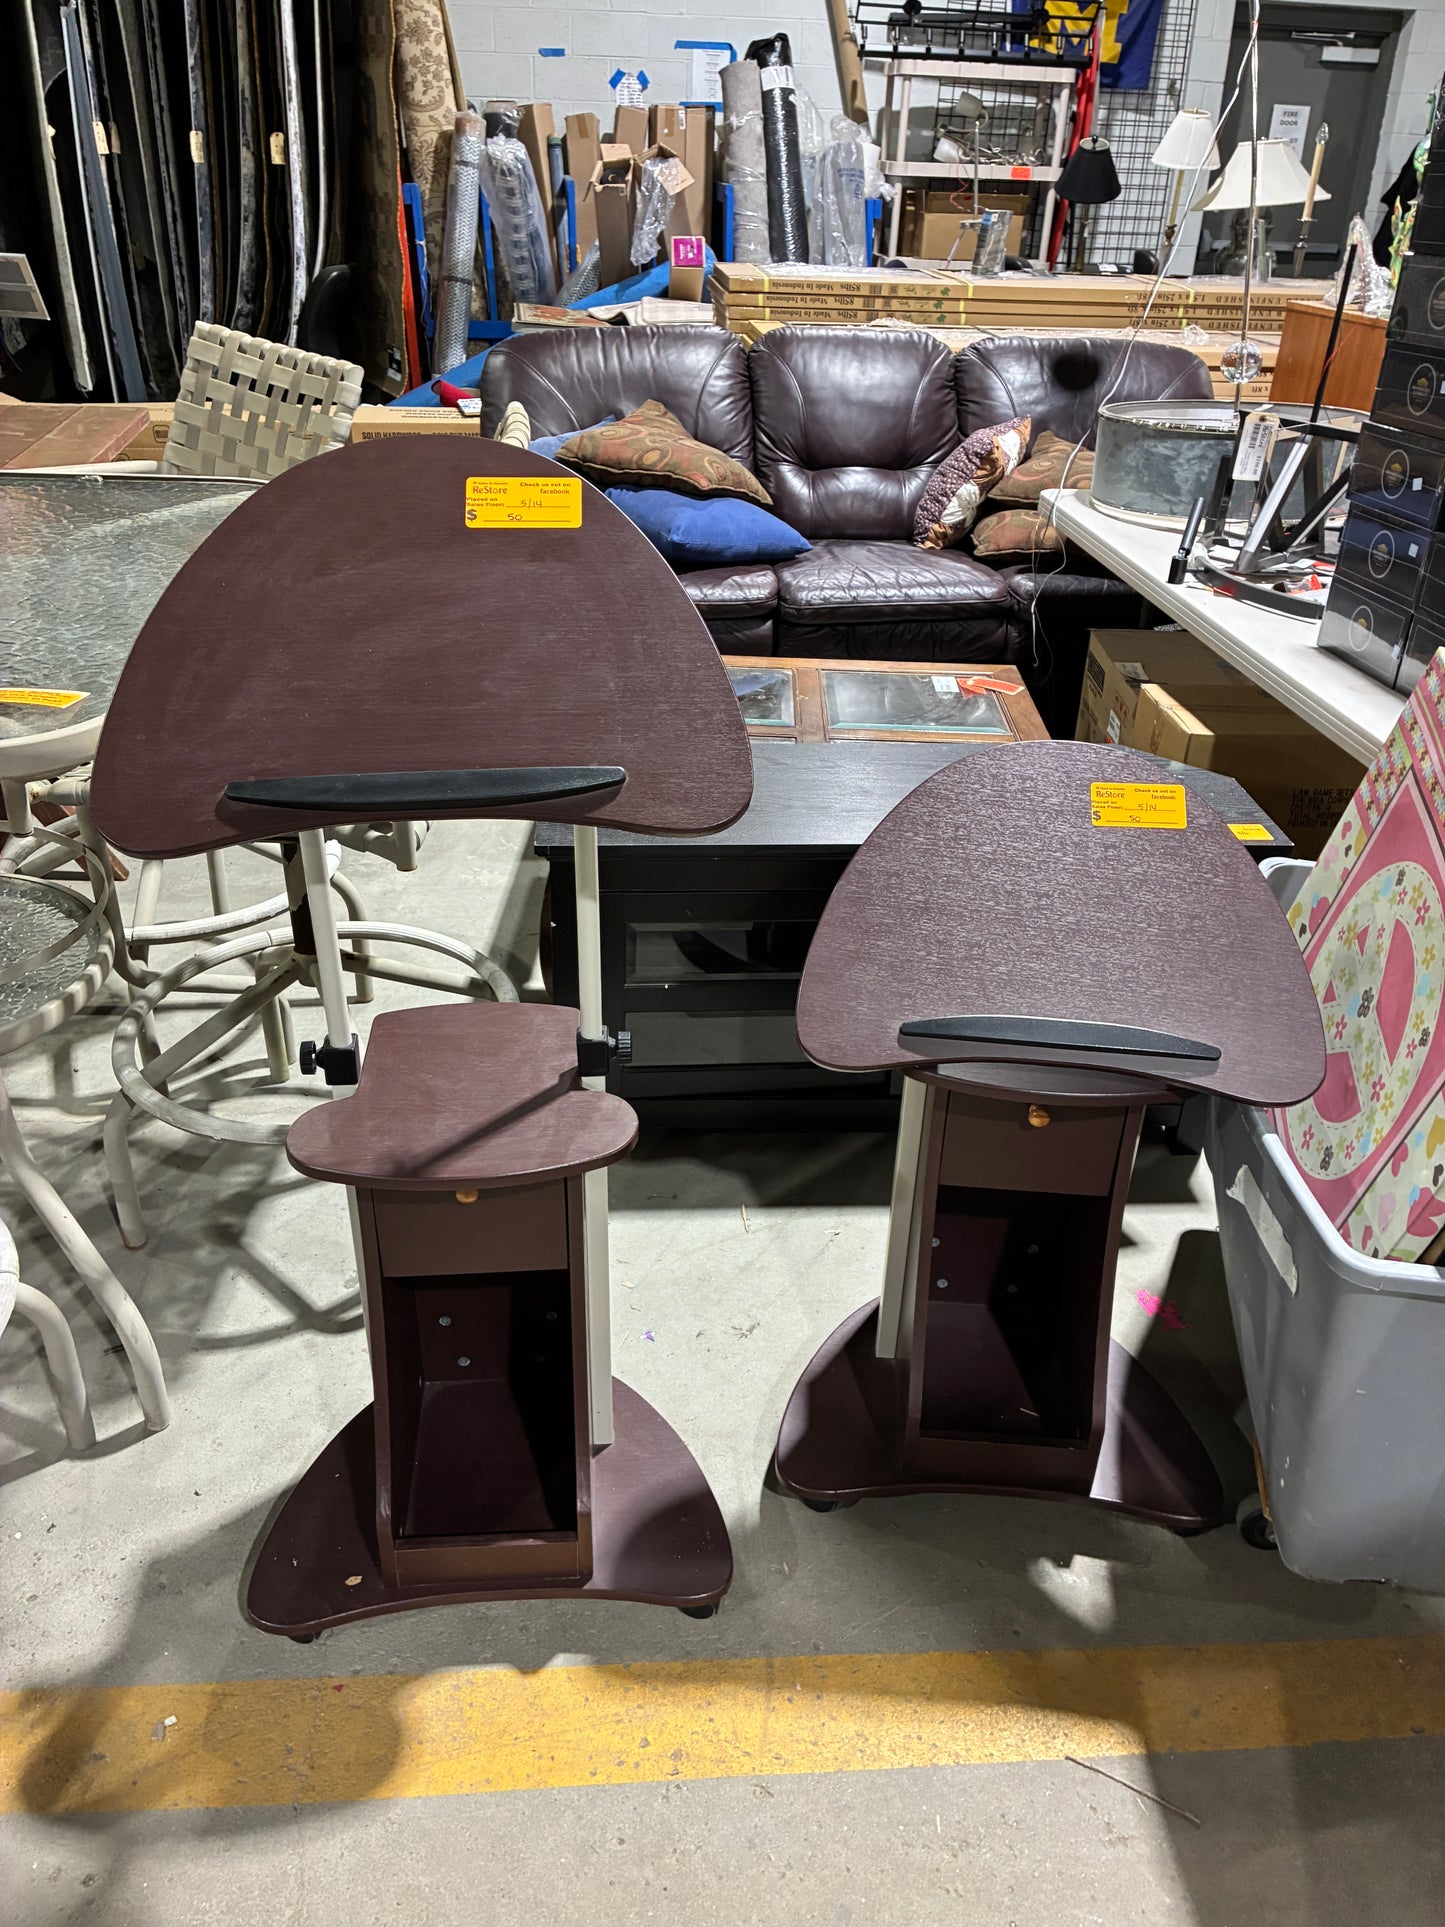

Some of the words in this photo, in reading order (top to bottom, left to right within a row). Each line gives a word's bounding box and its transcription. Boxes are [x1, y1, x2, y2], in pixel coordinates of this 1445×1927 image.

[772, 282, 804, 290] Indonesia
[806, 282, 813, 290] In
[816, 282, 834, 290] Made
[840, 282, 861, 292] 85lbs
[766, 295, 799, 303] Indonesia
[808, 296, 828, 304] Made
[834, 297, 854, 306] 85lbs
[1158, 293, 1176, 302] 25in
[1216, 296, 1280, 304] UNFINSHED
[813, 310, 831, 318] Made
[838, 310, 858, 319] 85lbs
[1150, 319, 1168, 328] 25in
[1208, 322, 1273, 330] UNFIISHED
[362, 432, 382, 440] SOLID
[472, 486, 508, 494] ReStore
[520, 499, 542, 509] 5/14
[466, 508, 478, 521] $
[507, 513, 522, 521] 50
[1096, 790, 1125, 798] ReStore
[1092, 810, 1102, 821] $
[1129, 815, 1140, 823] 50
